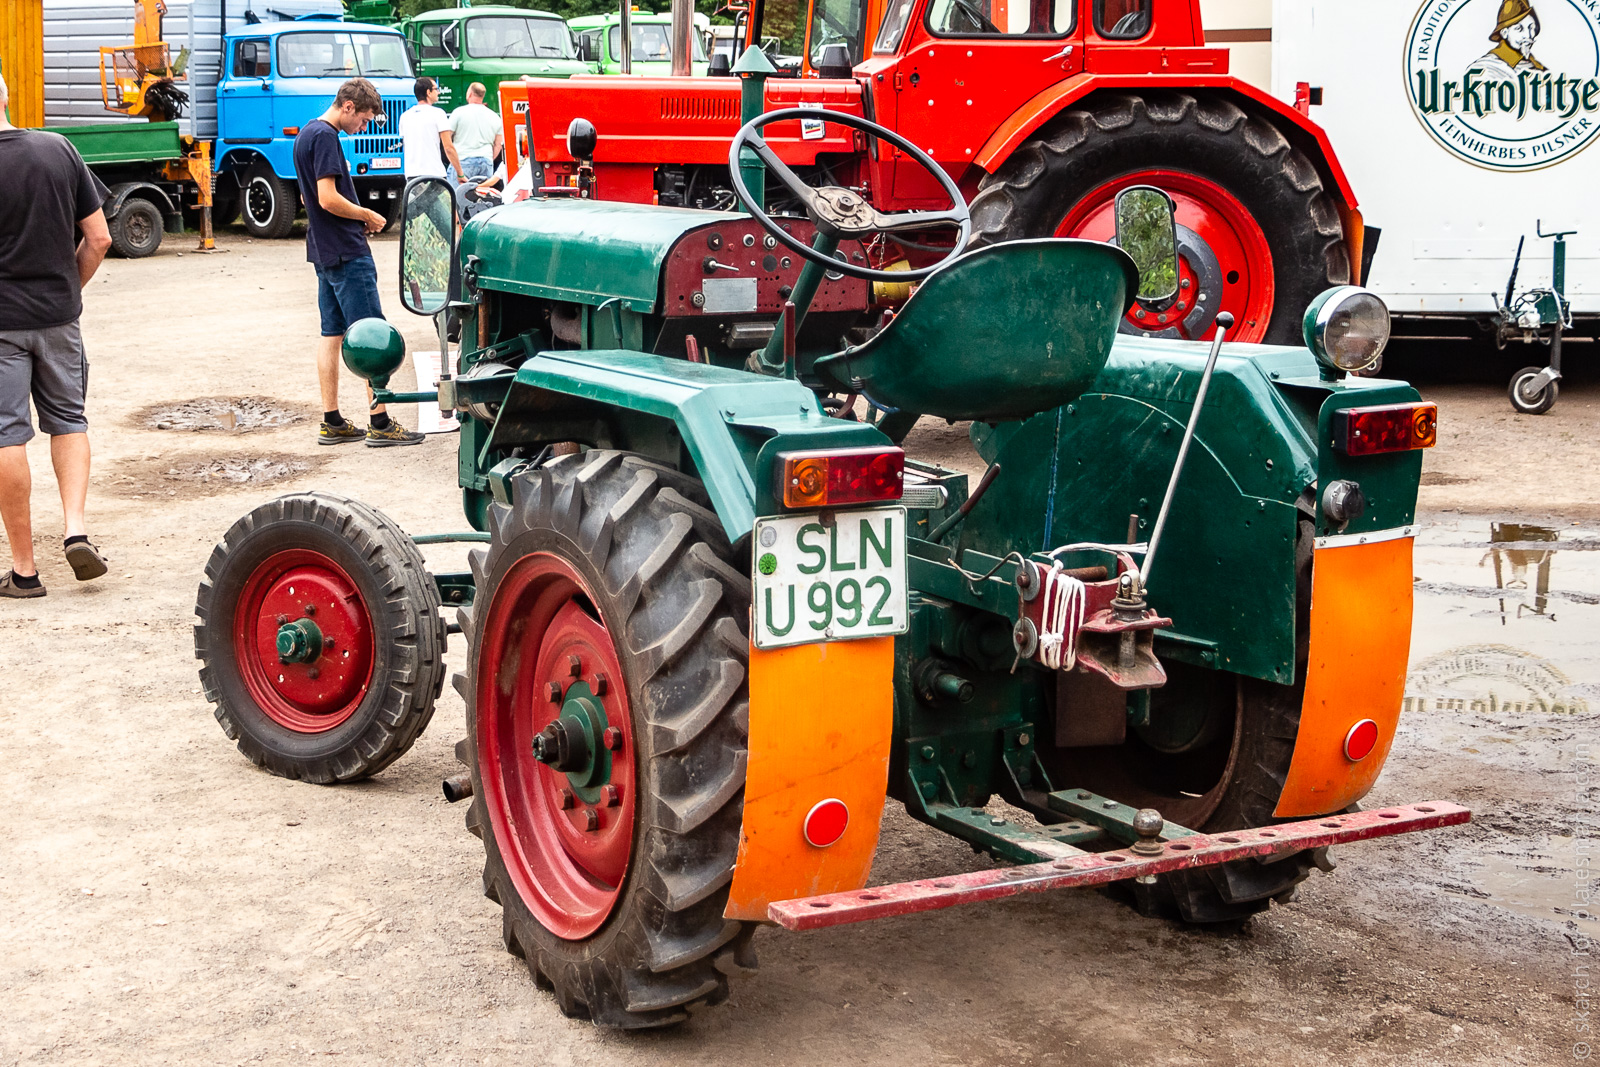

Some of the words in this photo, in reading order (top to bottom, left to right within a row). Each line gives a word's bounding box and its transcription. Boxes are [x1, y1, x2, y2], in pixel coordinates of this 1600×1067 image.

[1439, 118, 1526, 159] FEINHERBES
[1532, 117, 1592, 157] PILSNER
[796, 517, 892, 575] SLN
[765, 584, 795, 637] U
[807, 575, 893, 631] 992
